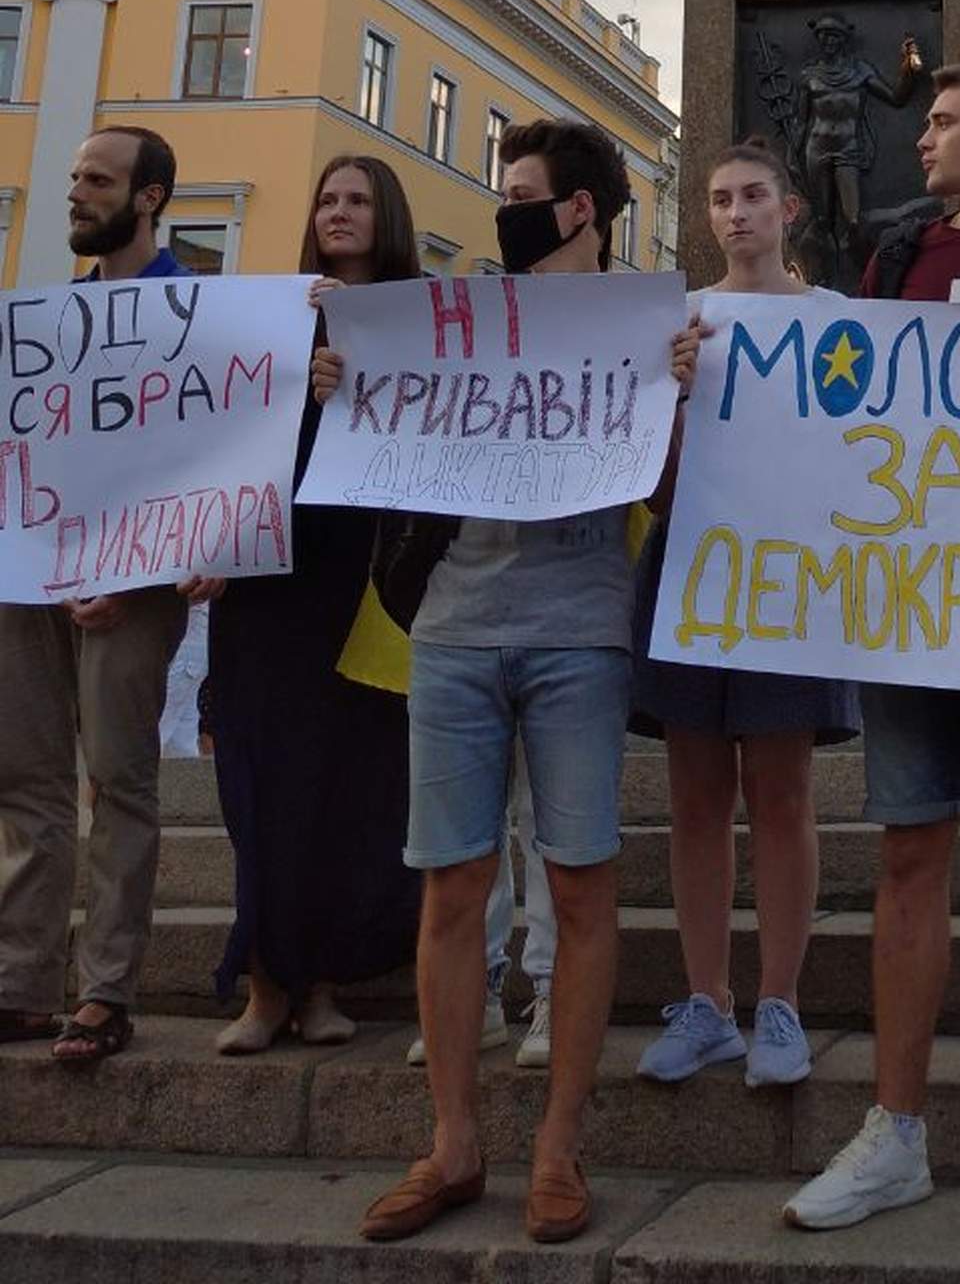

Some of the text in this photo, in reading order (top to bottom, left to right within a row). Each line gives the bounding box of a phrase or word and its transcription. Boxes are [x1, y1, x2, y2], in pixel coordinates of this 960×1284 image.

[0, 283, 199, 377] БОДУ
[428, 277, 520, 358] НІ
[10, 352, 272, 439] СЯБРАМ
[349, 358, 638, 441] КРИВАВІЙ
[43, 481, 287, 596] ДИКТАТОРА
